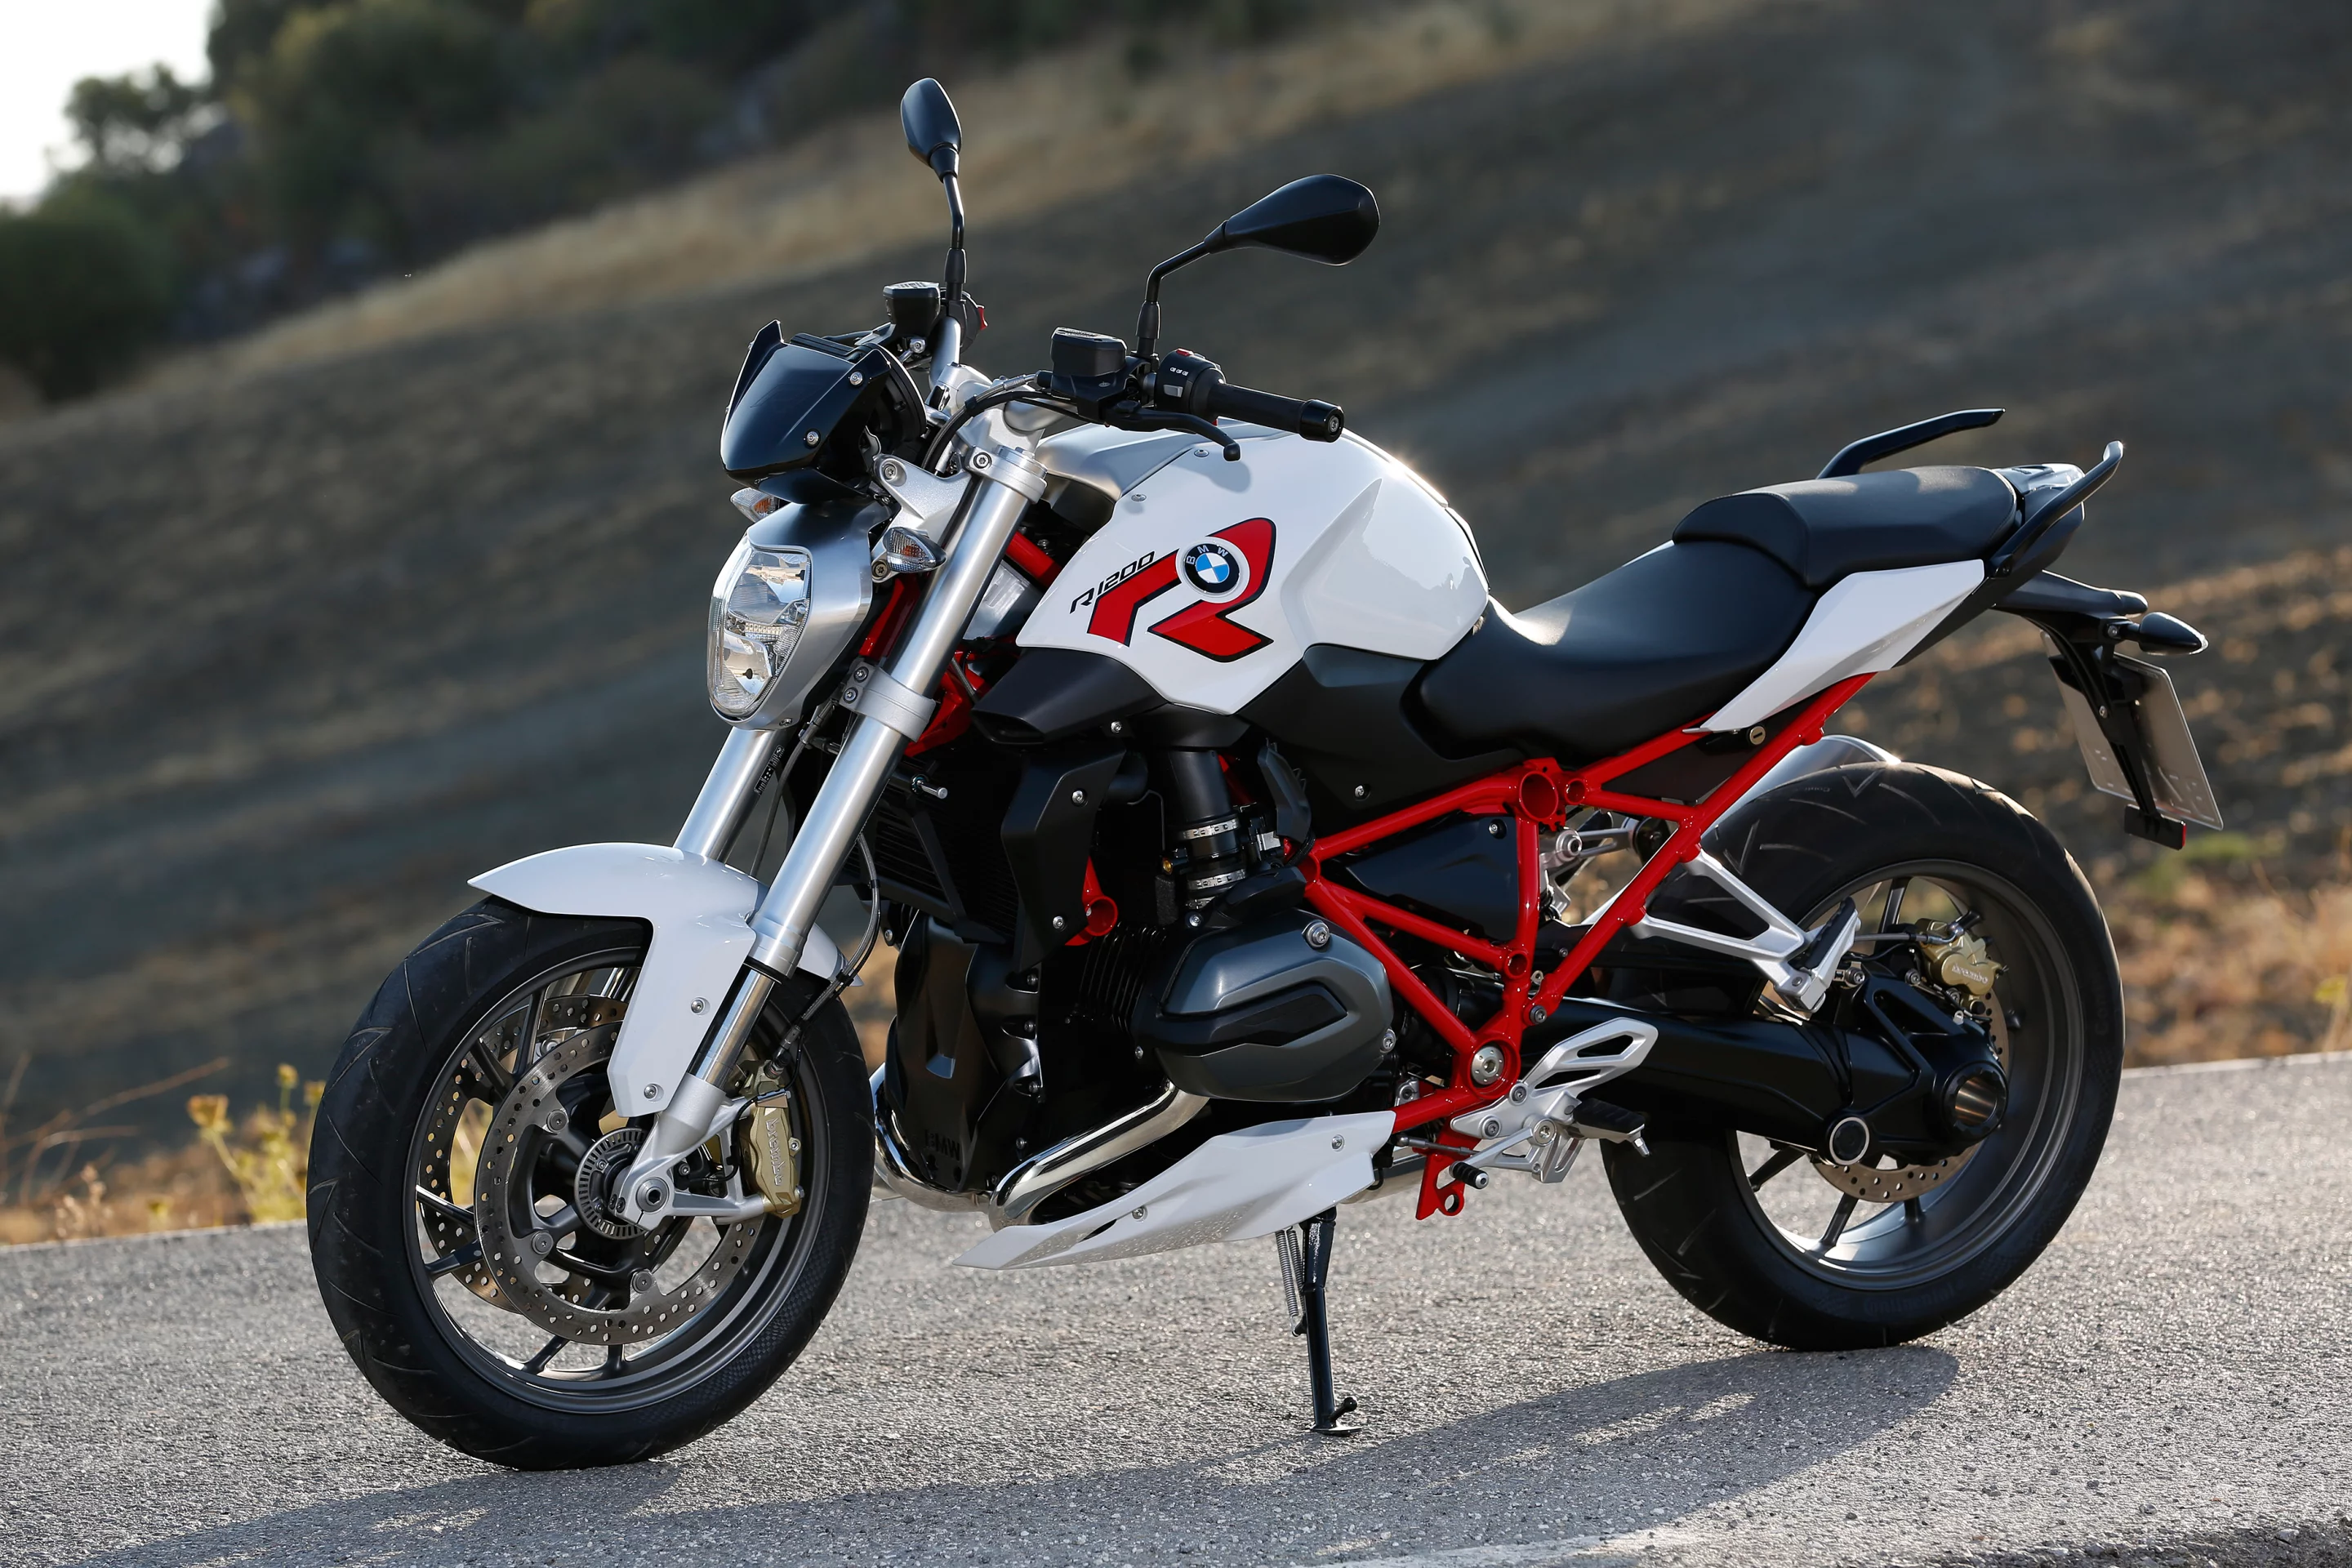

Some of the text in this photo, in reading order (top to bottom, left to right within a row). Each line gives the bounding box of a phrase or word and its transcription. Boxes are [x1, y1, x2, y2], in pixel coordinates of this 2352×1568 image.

[1185, 544, 1229, 565] BMW
[1951, 962, 1989, 984] brembo
[765, 1117, 787, 1187] brembo
[924, 1129, 960, 1161] BMW
